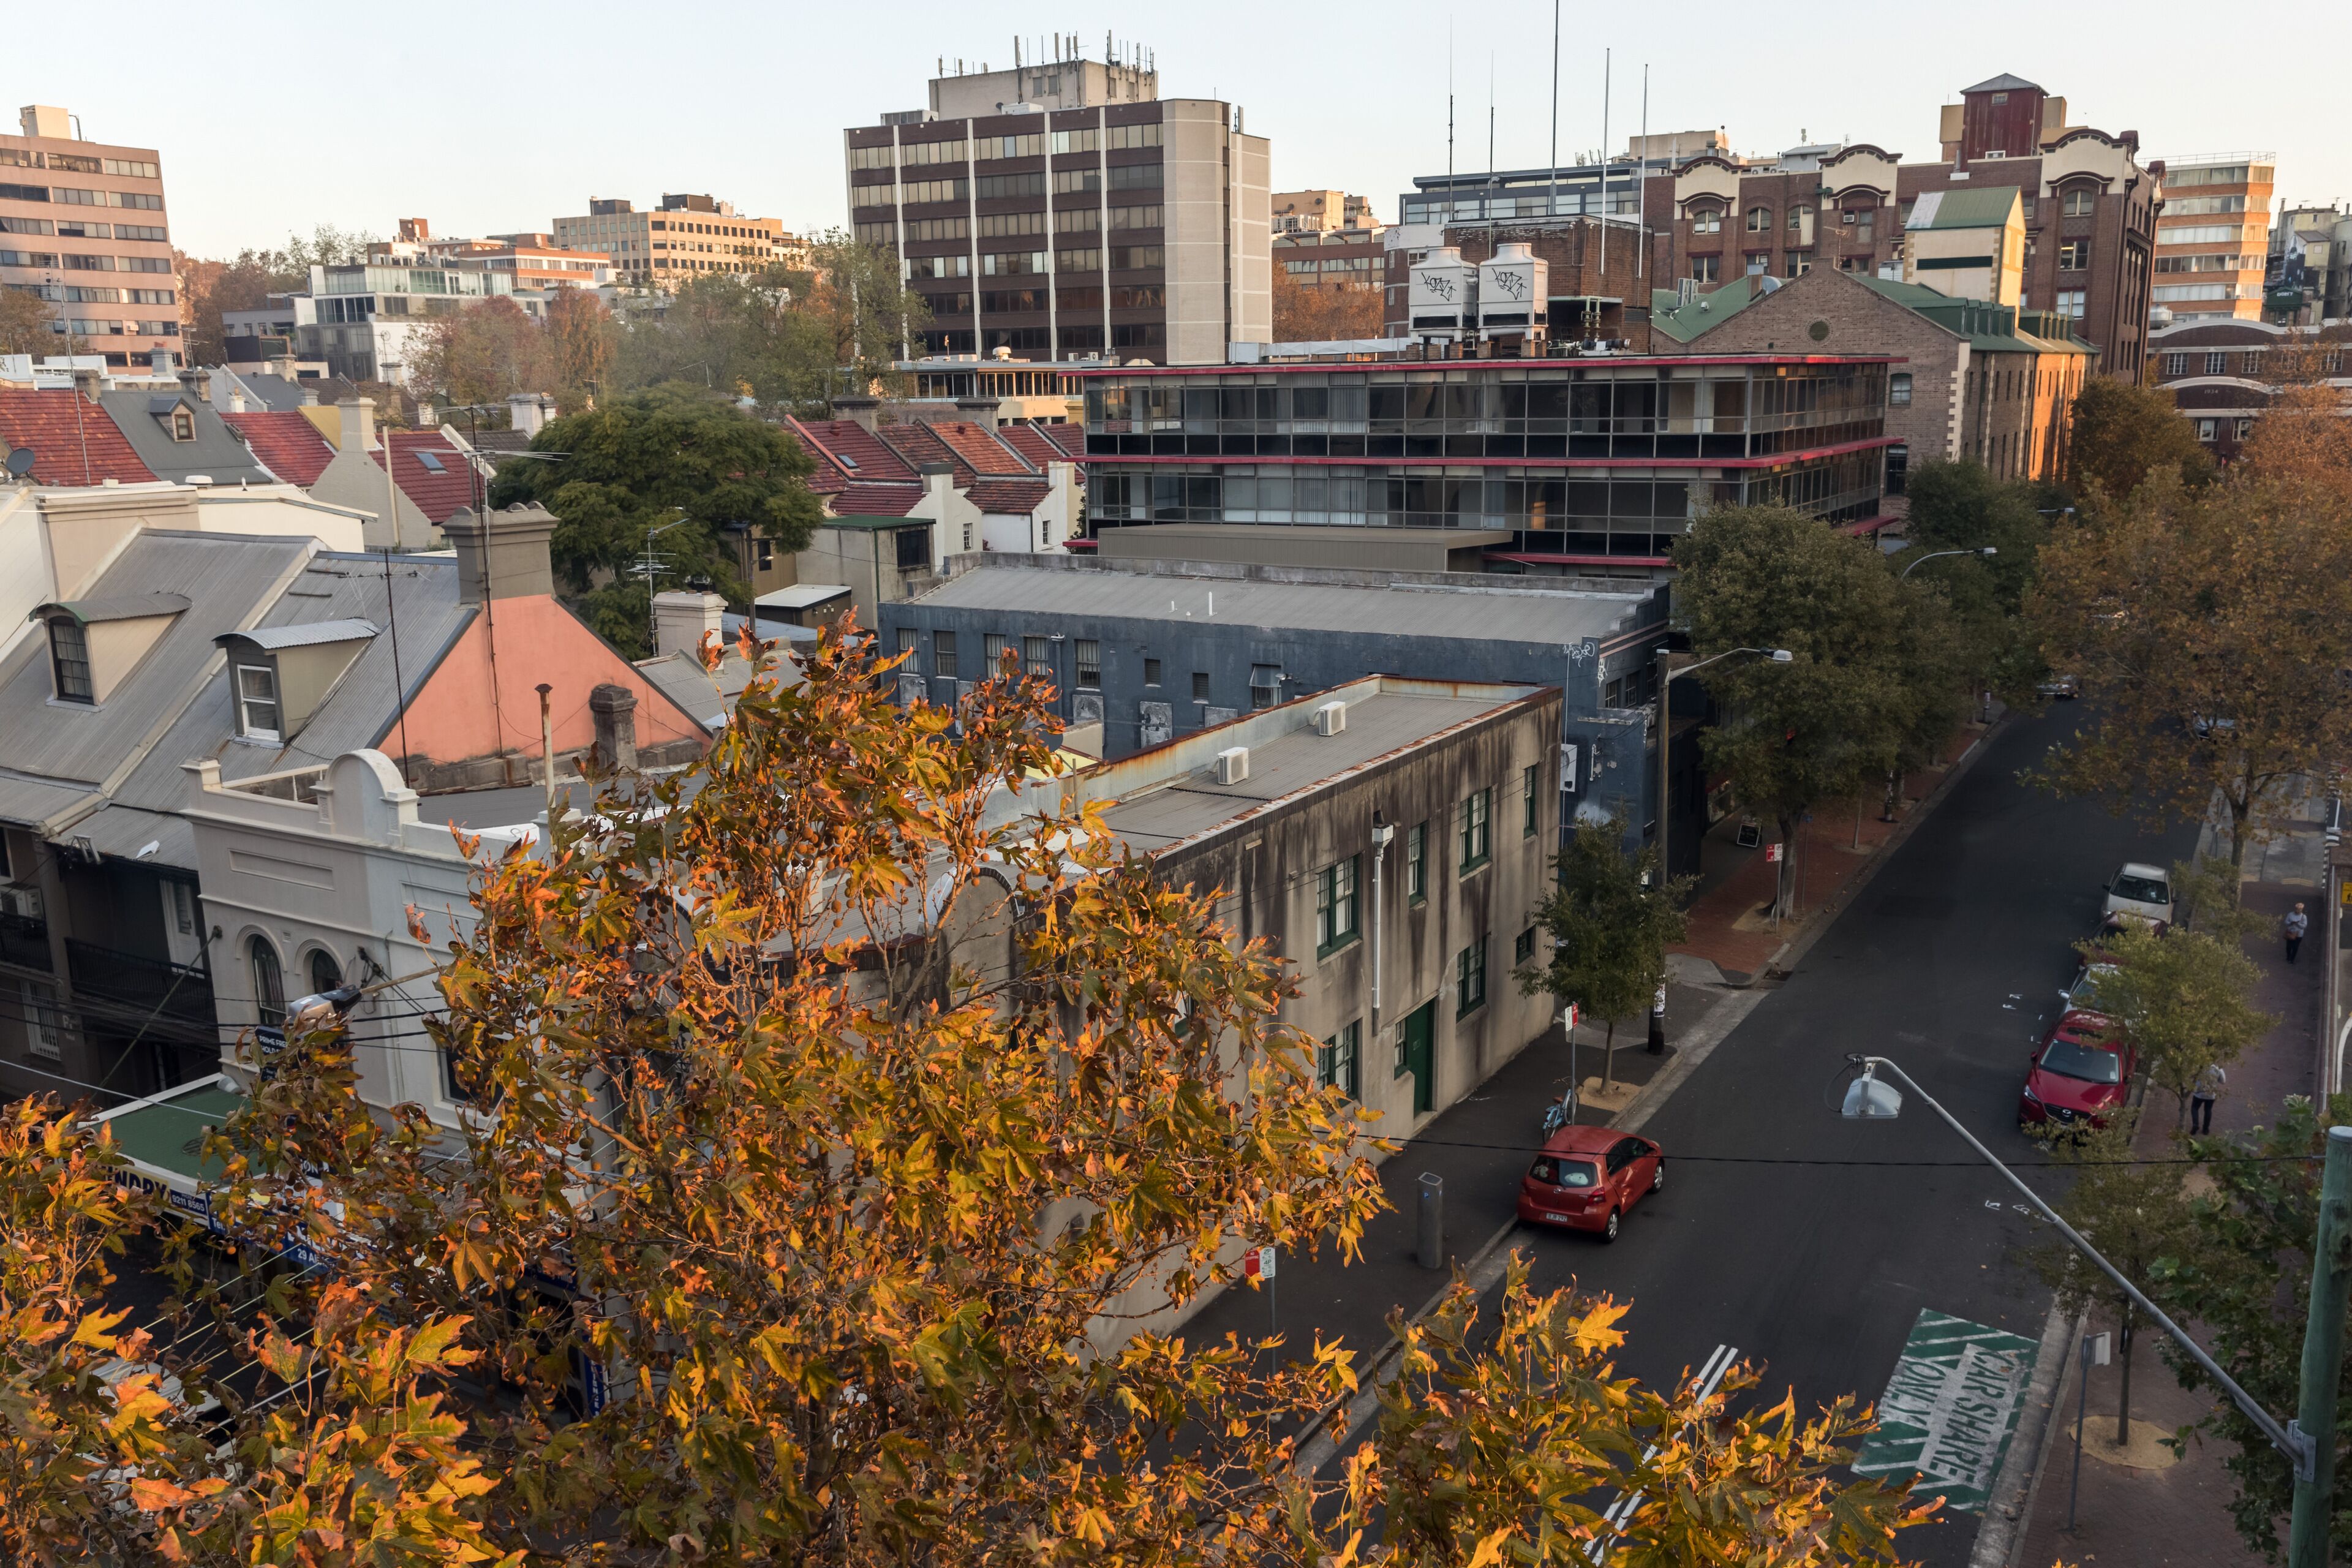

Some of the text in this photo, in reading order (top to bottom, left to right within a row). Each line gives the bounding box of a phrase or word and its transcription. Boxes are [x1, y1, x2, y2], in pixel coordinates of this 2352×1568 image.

[259, 1036, 275, 1046] PRIME
[172, 1194, 205, 1212] 9211 8565
[211, 1217, 226, 1231] Tel.
[297, 1248, 307, 1260] 29
[1887, 1361, 1947, 1426] ONLY
[1929, 1352, 2015, 1483] CAR SHARE
